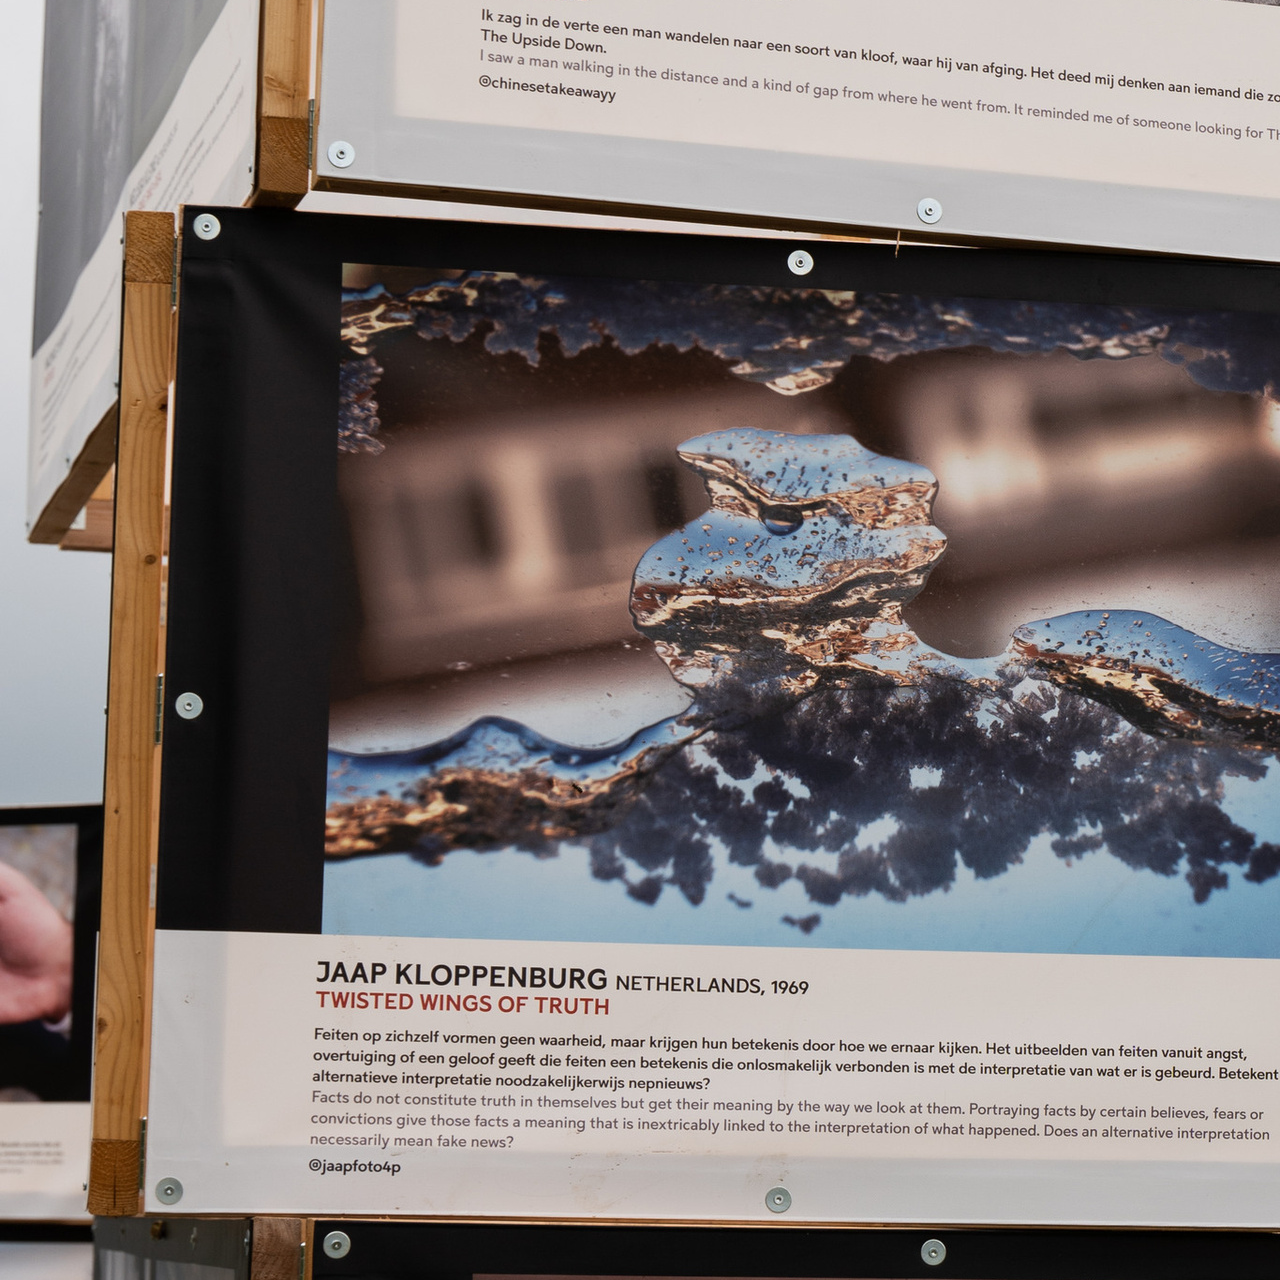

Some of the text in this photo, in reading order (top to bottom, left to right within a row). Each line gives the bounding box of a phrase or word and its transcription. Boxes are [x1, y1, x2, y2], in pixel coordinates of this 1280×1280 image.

[480, 28, 607, 54] The Upside Down.
[481, 8, 494, 22] Ik
[497, 13, 522, 28] zag
[525, 13, 538, 27] in
[541, 15, 560, 29] de
[563, 20, 600, 33] verte
[602, 25, 629, 36] een
[632, 28, 662, 40] man
[664, 31, 730, 47] wandelen
[733, 38, 763, 50] naar
[766, 42, 791, 53] een
[794, 44, 830, 57] soort
[833, 49, 857, 60] van
[861, 48, 898, 66] kloof,
[901, 56, 933, 68] waar
[936, 56, 952, 73] hij
[955, 61, 979, 72] van
[982, 61, 1027, 81] afging.
[1030, 65, 1055, 80] Het
[1057, 69, 1091, 84] deed
[1094, 73, 1114, 90] mij
[1117, 75, 1165, 91] denken
[1167, 83, 1191, 94] aan
[1194, 82, 1241, 99] iemand
[1243, 88, 1264, 101] die
[478, 74, 617, 104] @chinesetakeawayy
[316, 960, 810, 996] JAAP KLOPPENBURG NETHERLANDS, 1969
[315, 990, 610, 1016] TWISTED WINGS OF TRUTH
[312, 1069, 711, 1093] alternatieve interpretatie noodzakelijkerwijs nepnieuws?
[310, 1133, 514, 1150] necessarily mean fake news?
[308, 1158, 402, 1177] @jaapfoto4p
